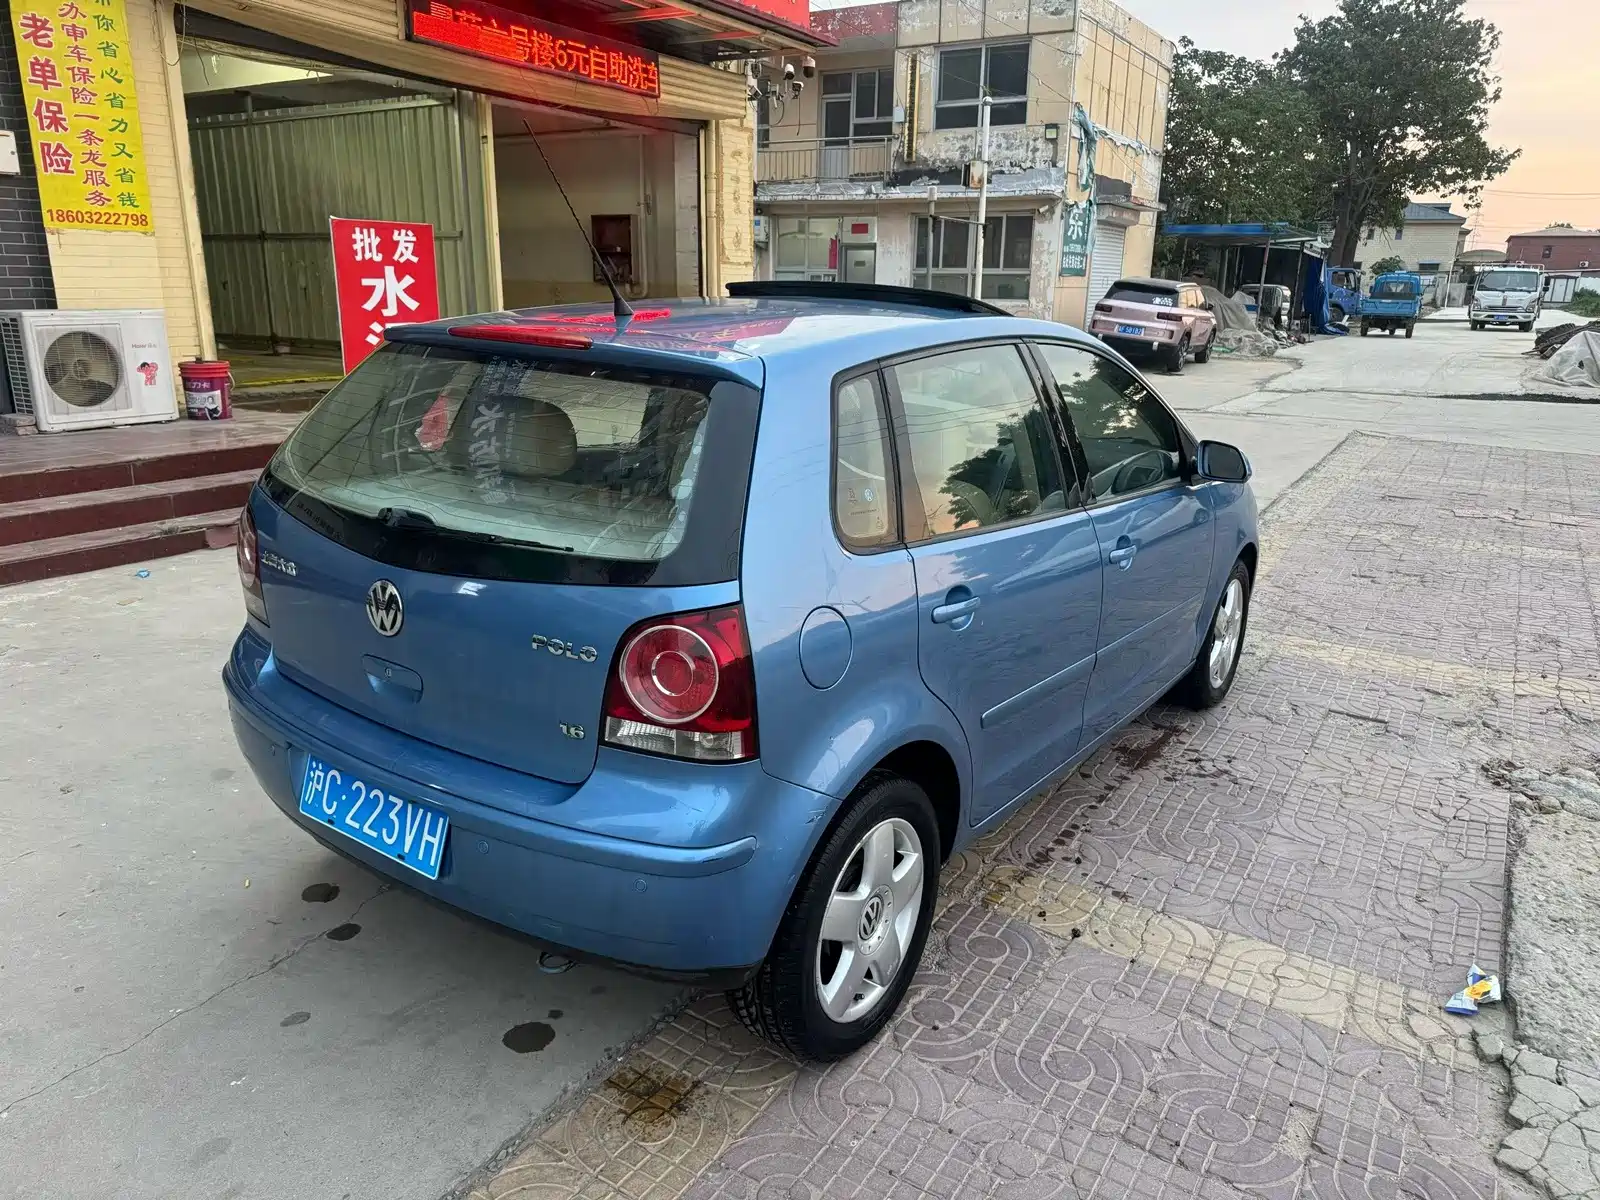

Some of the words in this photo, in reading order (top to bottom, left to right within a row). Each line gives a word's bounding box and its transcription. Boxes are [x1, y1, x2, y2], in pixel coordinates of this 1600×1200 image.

[20, 13, 75, 175] 老单保险
[93, 0, 139, 208] 你省心省力又省钱
[46, 208, 149, 227] 18603222798
[352, 227, 419, 263] 批发
[532, 633, 598, 663] POLO
